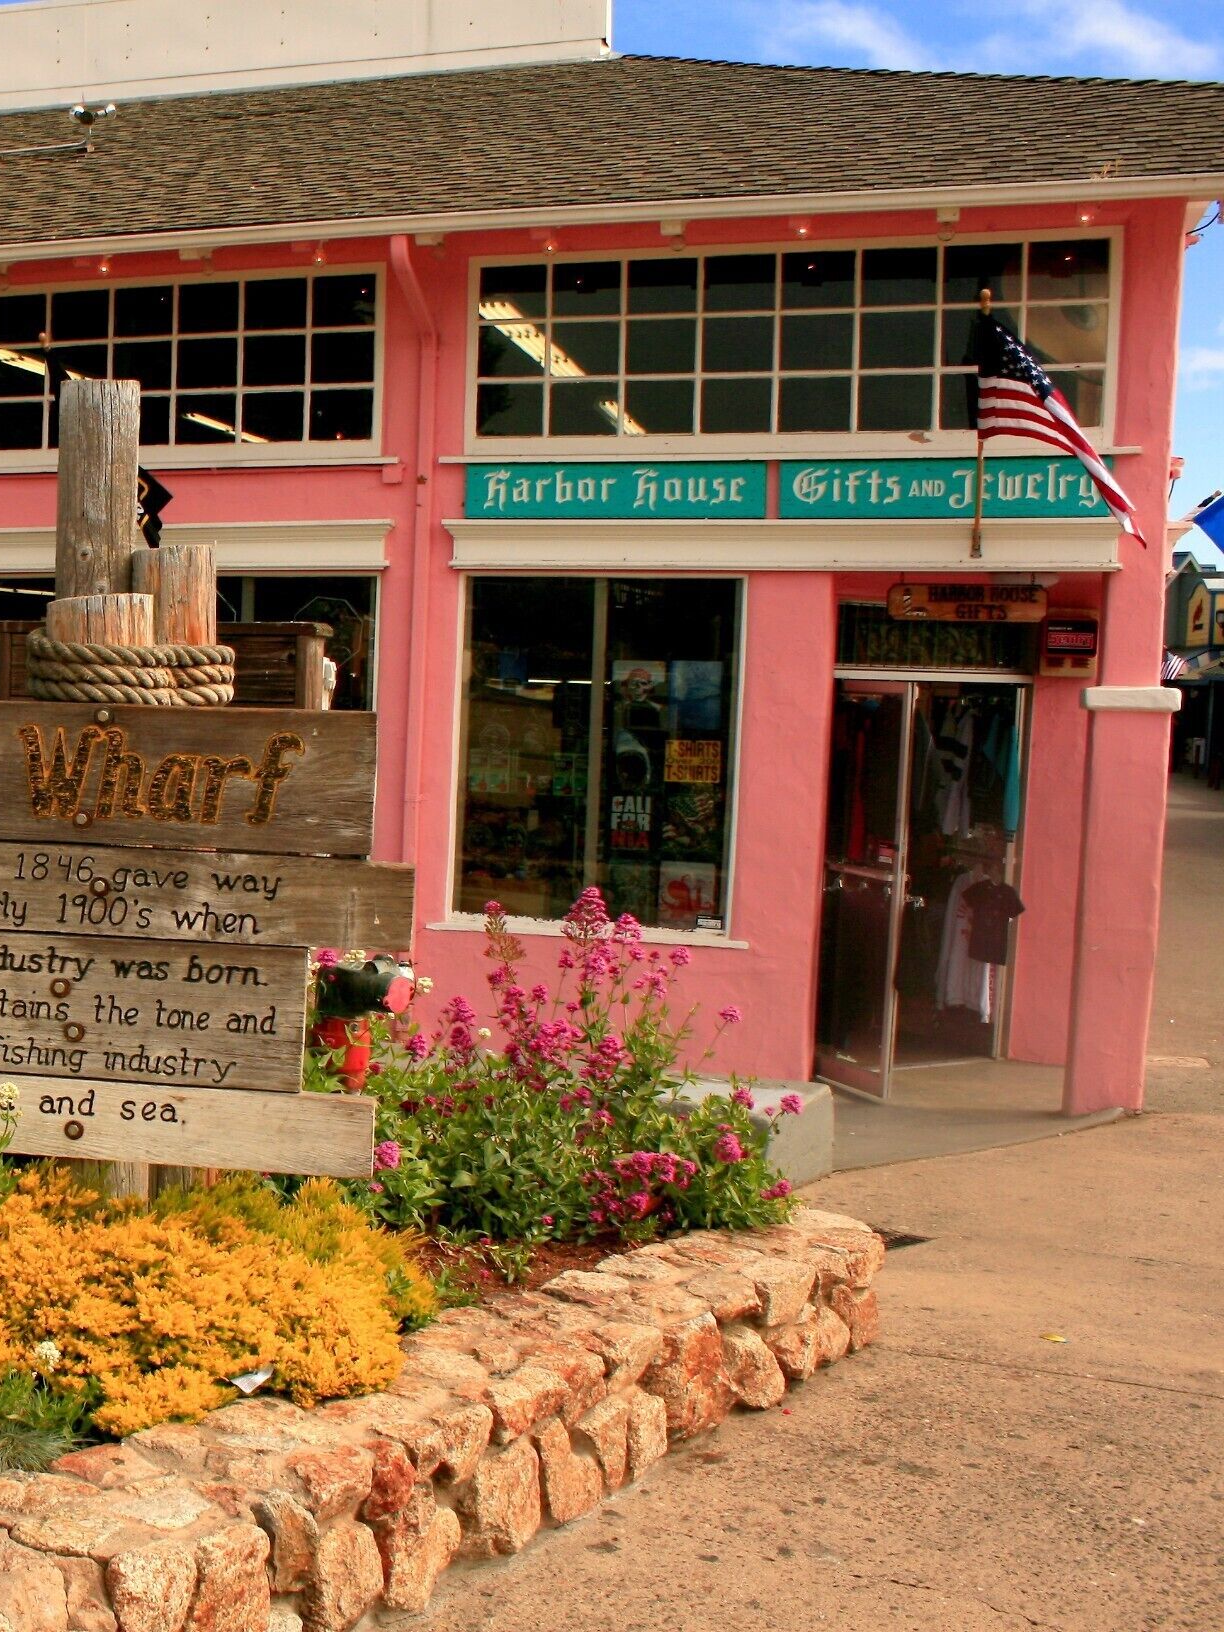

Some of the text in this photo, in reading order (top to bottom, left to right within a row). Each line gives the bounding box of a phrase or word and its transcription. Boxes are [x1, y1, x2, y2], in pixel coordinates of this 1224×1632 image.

[483, 468, 746, 511] Harbor House
[792, 463, 1102, 508] Gifts AND Jewelry
[955, 604, 1007, 620] GIFTS
[990, 586, 1038, 602] HOUSE
[667, 741, 719, 758] T-SHIRTS
[18, 723, 306, 826] Wharf
[113, 867, 189, 896] gave
[212, 868, 281, 900] way
[56, 893, 151, 929] 1900's
[171, 903, 261, 936] when
[111, 957, 169, 981] was
[94, 995, 139, 1027] the
[155, 999, 210, 1031] tone
[226, 1005, 277, 1035] and
[103, 1044, 237, 1082] industry
[38, 1090, 95, 1116] and
[120, 1101, 186, 1125] sea.
